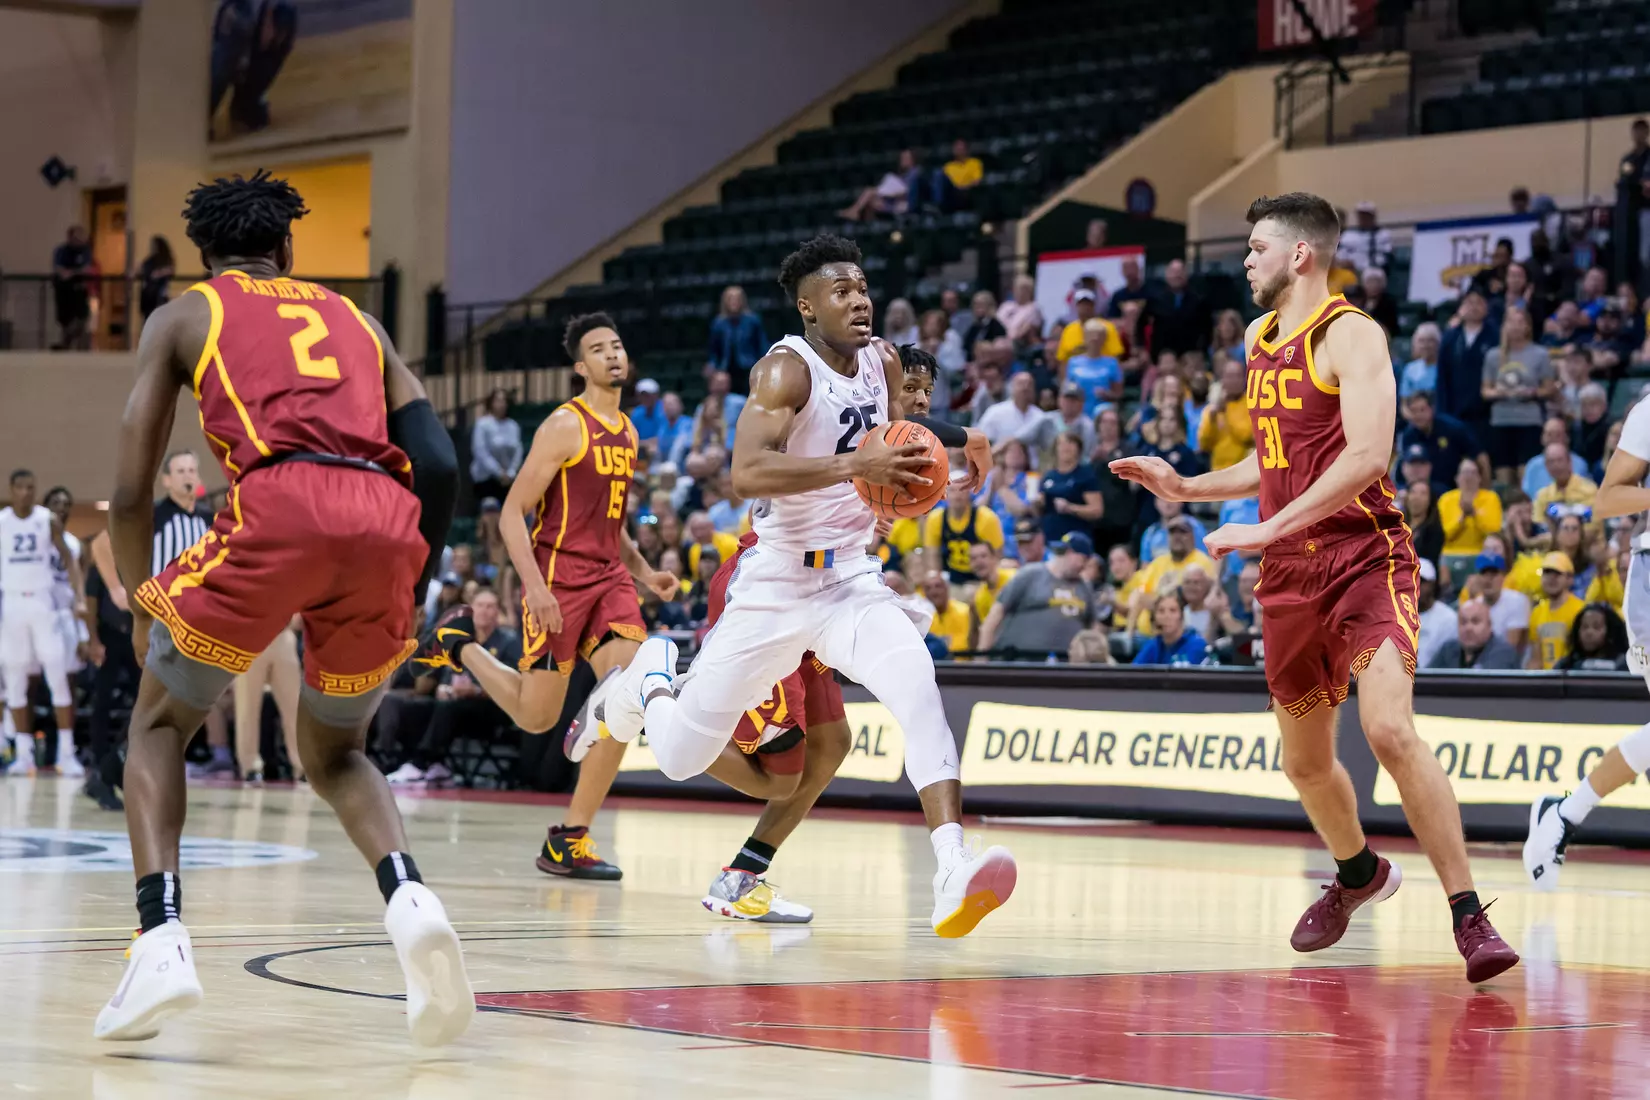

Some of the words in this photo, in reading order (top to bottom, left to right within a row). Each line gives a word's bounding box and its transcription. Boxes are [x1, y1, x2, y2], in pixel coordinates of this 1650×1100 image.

[233, 277, 327, 301] MATHEWS
[276, 303, 341, 380] 2
[1246, 368, 1303, 410] USC
[592, 445, 635, 479] USC
[1257, 416, 1289, 470] 31
[606, 479, 627, 519] 15
[13, 532, 37, 553] 23
[983, 727, 1117, 766] DOLLAR
[1129, 732, 1283, 772] GENERAL
[1434, 742, 1563, 783] OLLAR
